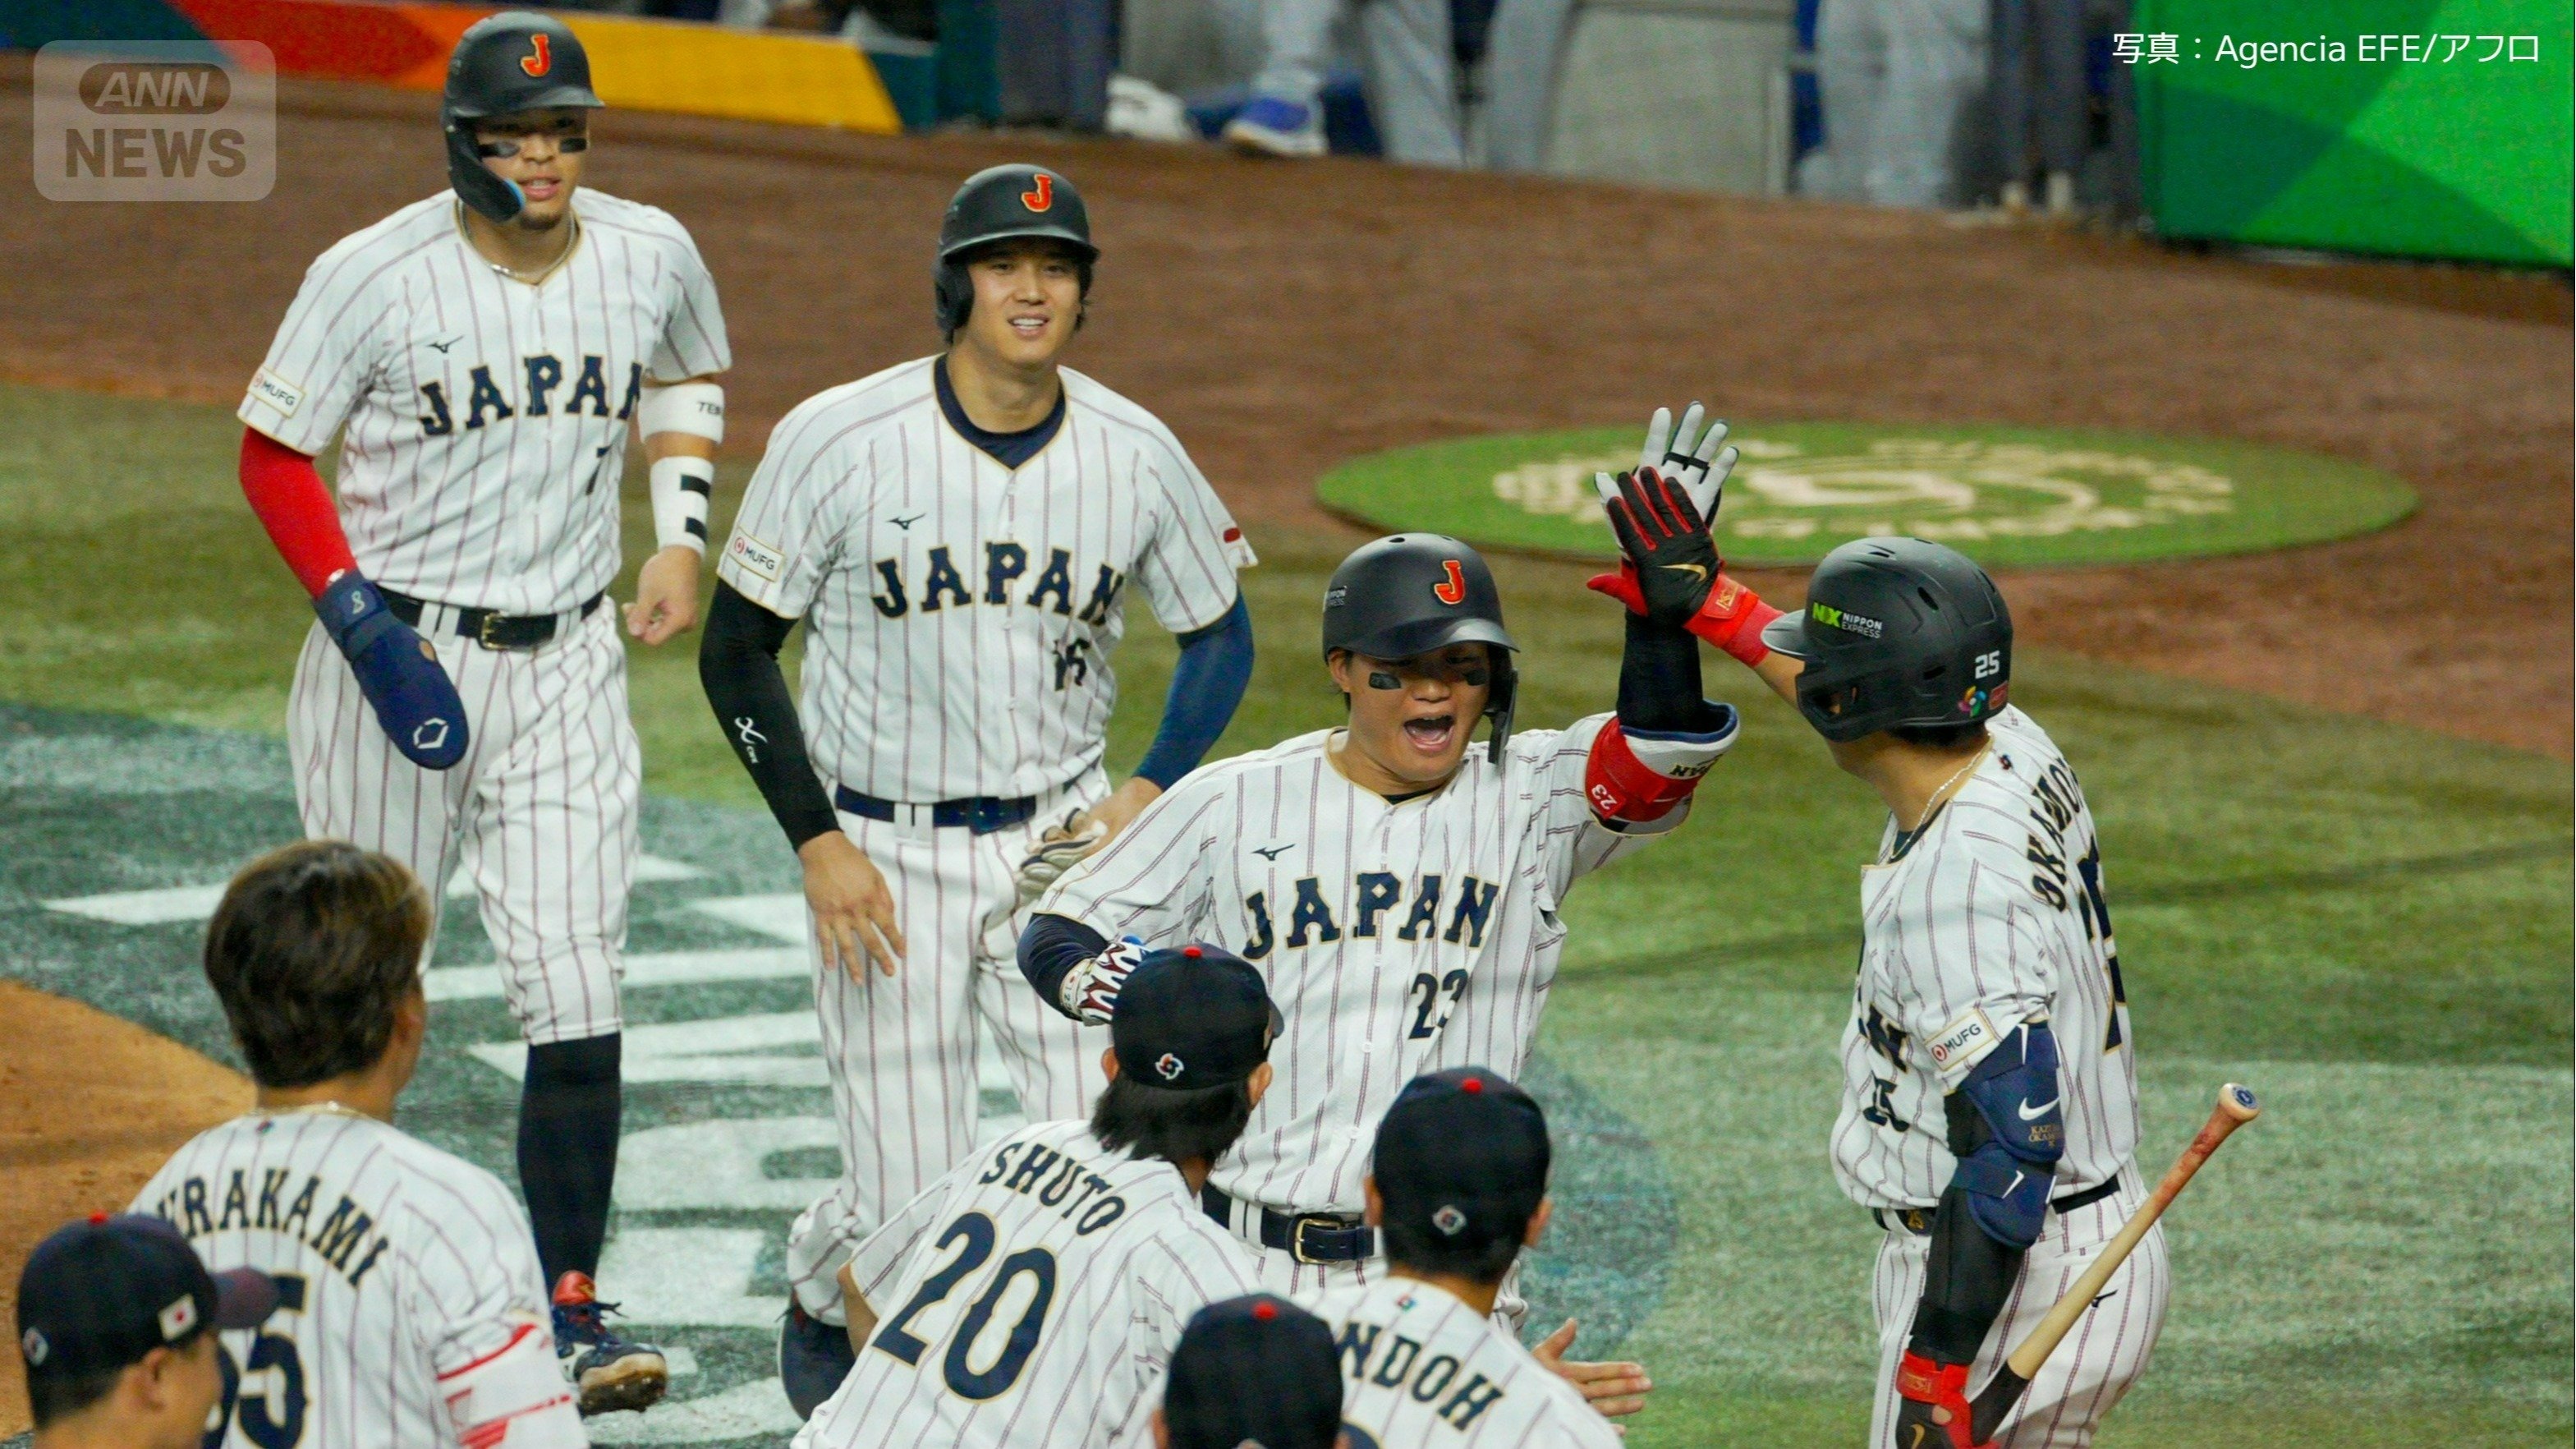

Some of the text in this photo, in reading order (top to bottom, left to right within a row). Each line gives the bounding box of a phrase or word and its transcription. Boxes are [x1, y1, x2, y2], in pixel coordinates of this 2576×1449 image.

[521, 34, 551, 77] J
[1021, 173, 1053, 213] J
[263, 380, 296, 406] MUFG
[744, 547, 775, 570] MUFG
[1435, 559, 1466, 605] J
[1812, 601, 1844, 628] NX
[1842, 612, 1882, 631] NIPPON
[1841, 621, 1881, 639] EXPRESS
[1974, 650, 2000, 680] 25
[1591, 784, 1619, 811] 23
[1242, 871, 1500, 959] JAPAN
[1947, 1024, 1981, 1053] MUFG
[978, 1142, 1126, 1236] SHUTO
[870, 1212, 1058, 1401] 20
